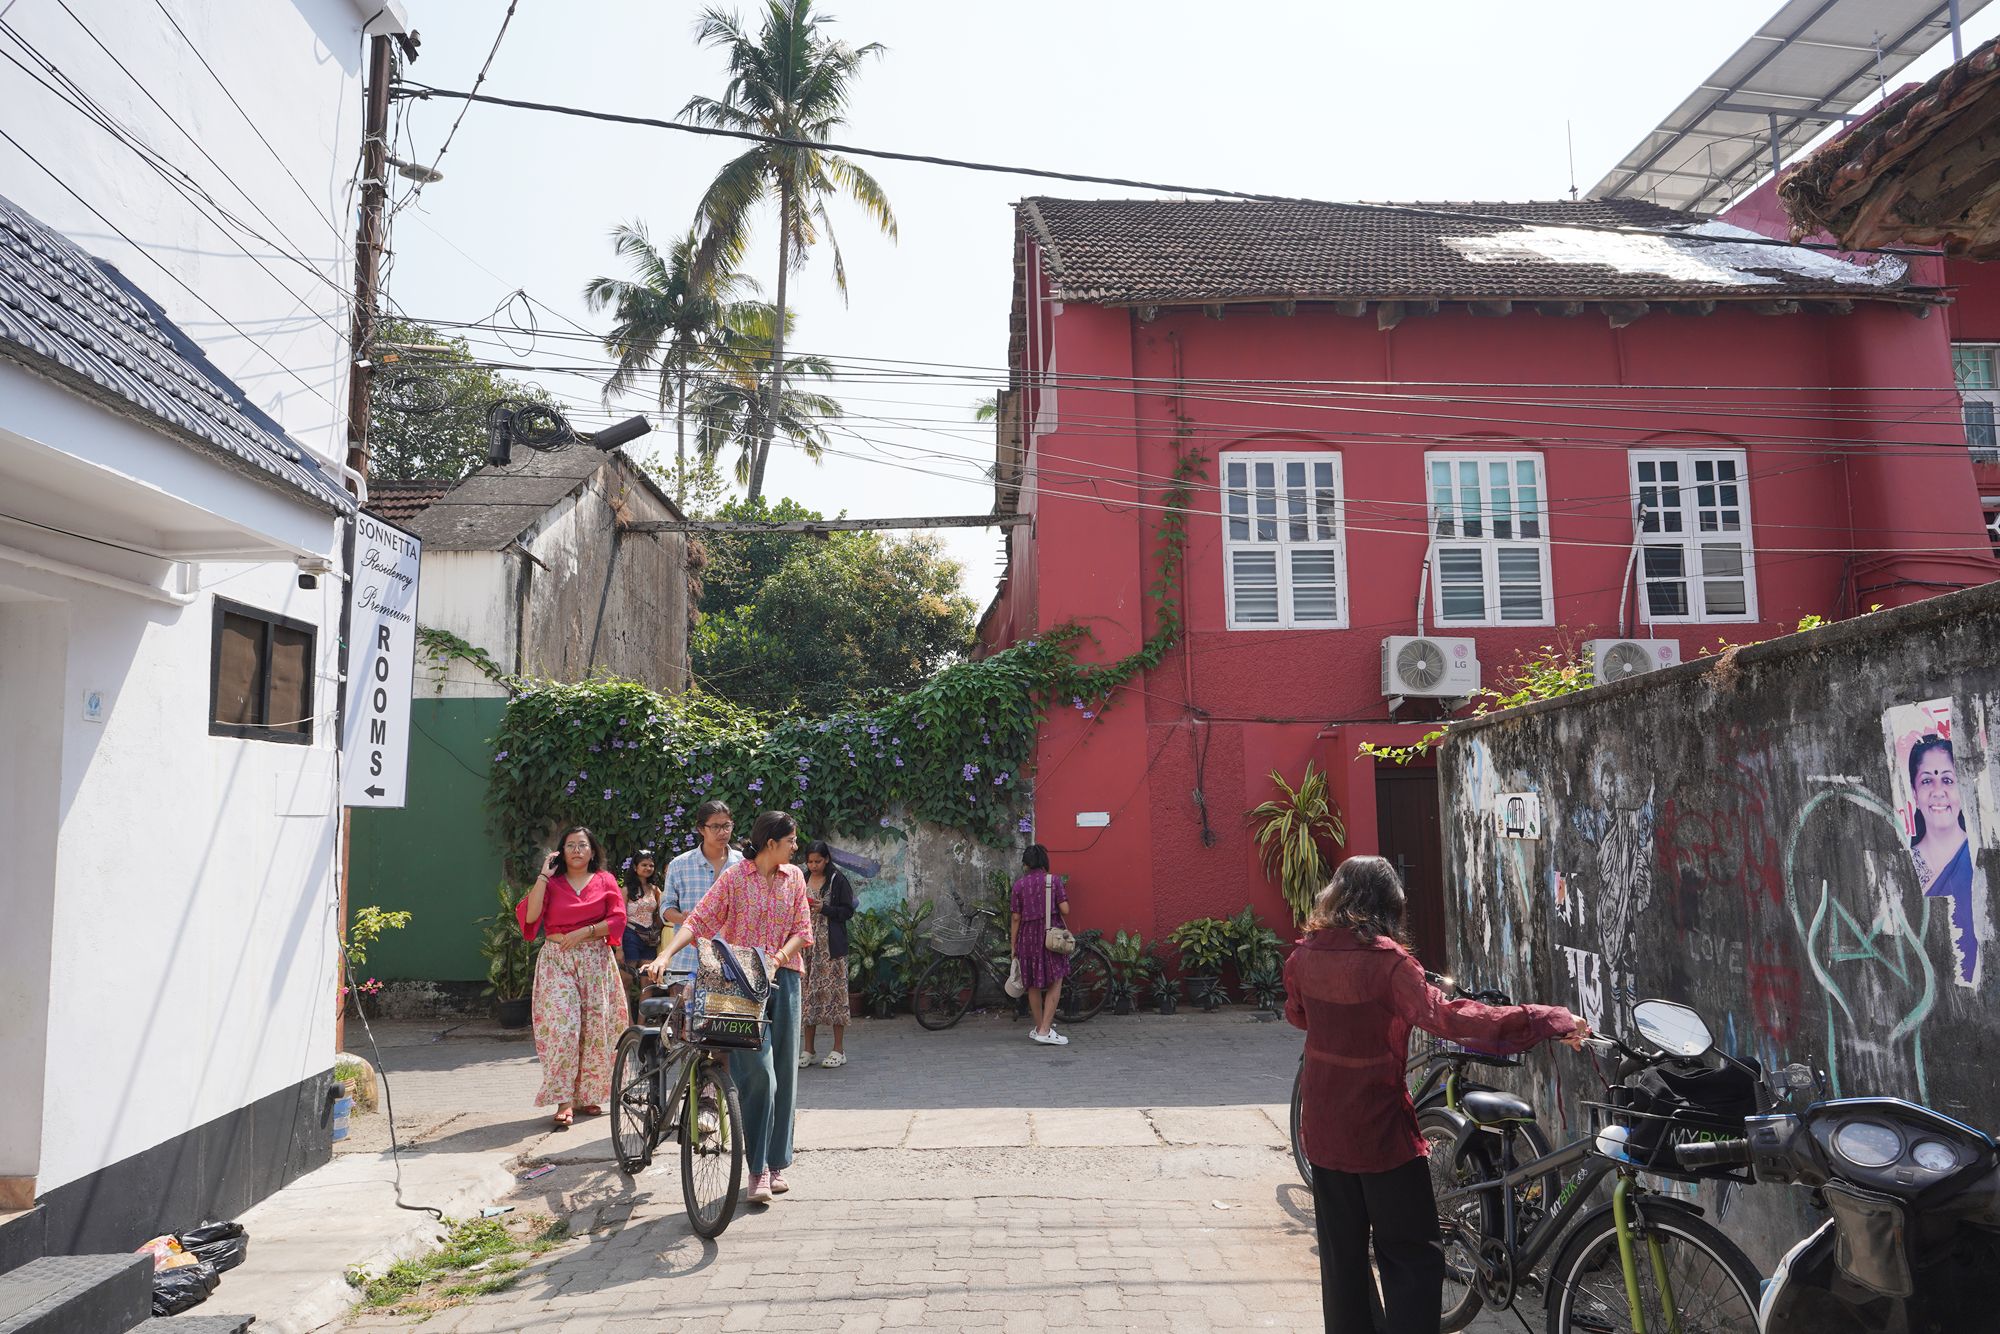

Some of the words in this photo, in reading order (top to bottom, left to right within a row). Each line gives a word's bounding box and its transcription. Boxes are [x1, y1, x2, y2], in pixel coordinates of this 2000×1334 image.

[359, 518, 418, 560] SONNETTA
[361, 548, 413, 590] Residency
[358, 585, 411, 623] Premium
[1454, 660, 1467, 669] LG
[369, 623, 391, 777] ROOMS
[1688, 930, 1743, 974] LOVE
[711, 1020, 753, 1034] MYBYK
[1550, 1178, 1577, 1219] MYBYK
